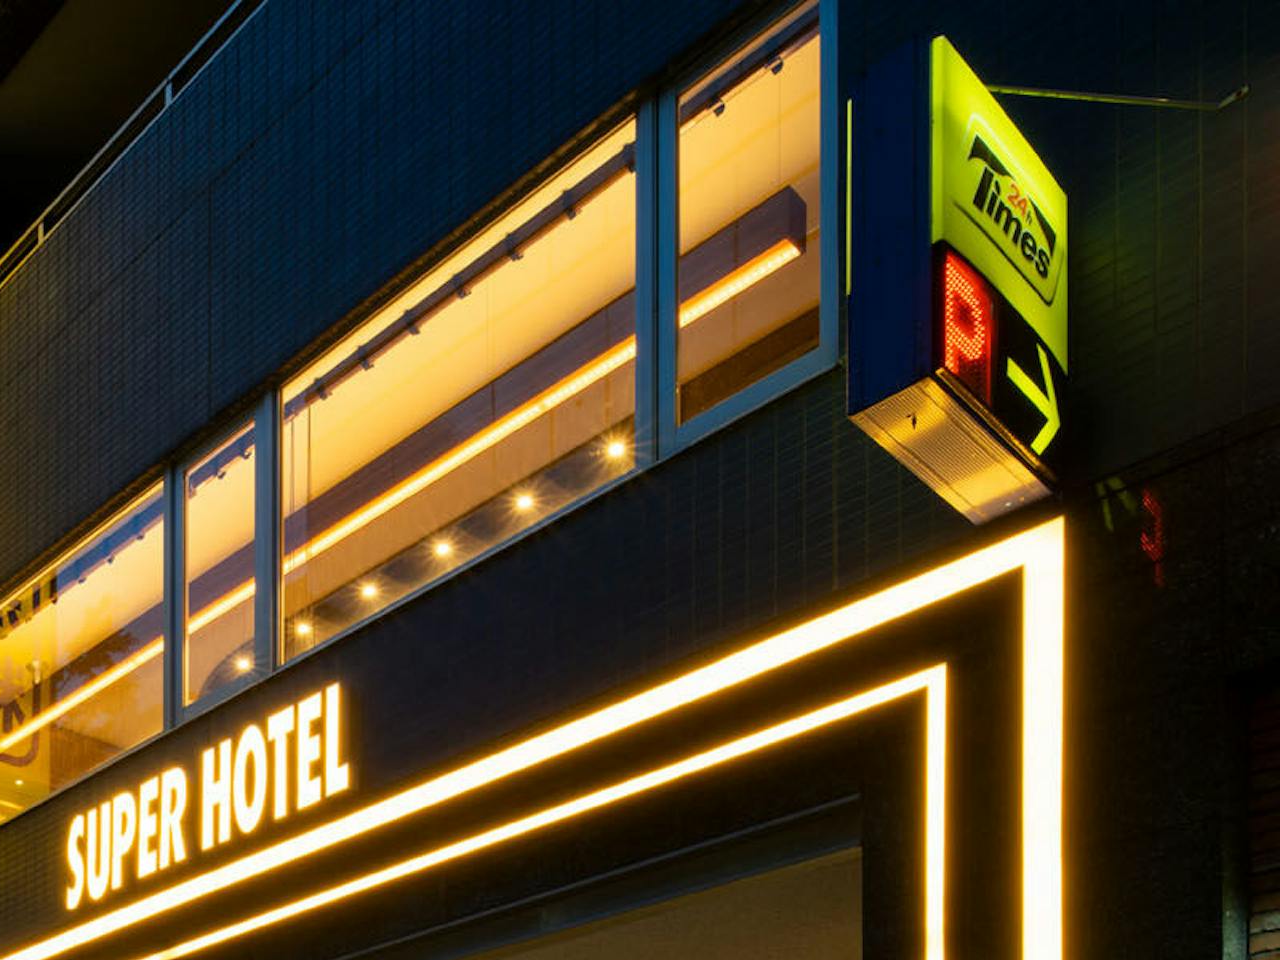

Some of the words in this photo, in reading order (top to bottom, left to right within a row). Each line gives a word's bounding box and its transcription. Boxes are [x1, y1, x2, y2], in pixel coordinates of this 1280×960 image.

[968, 138, 1054, 279] Times
[65, 766, 188, 910] SUPER
[200, 682, 351, 852] HOTEL
